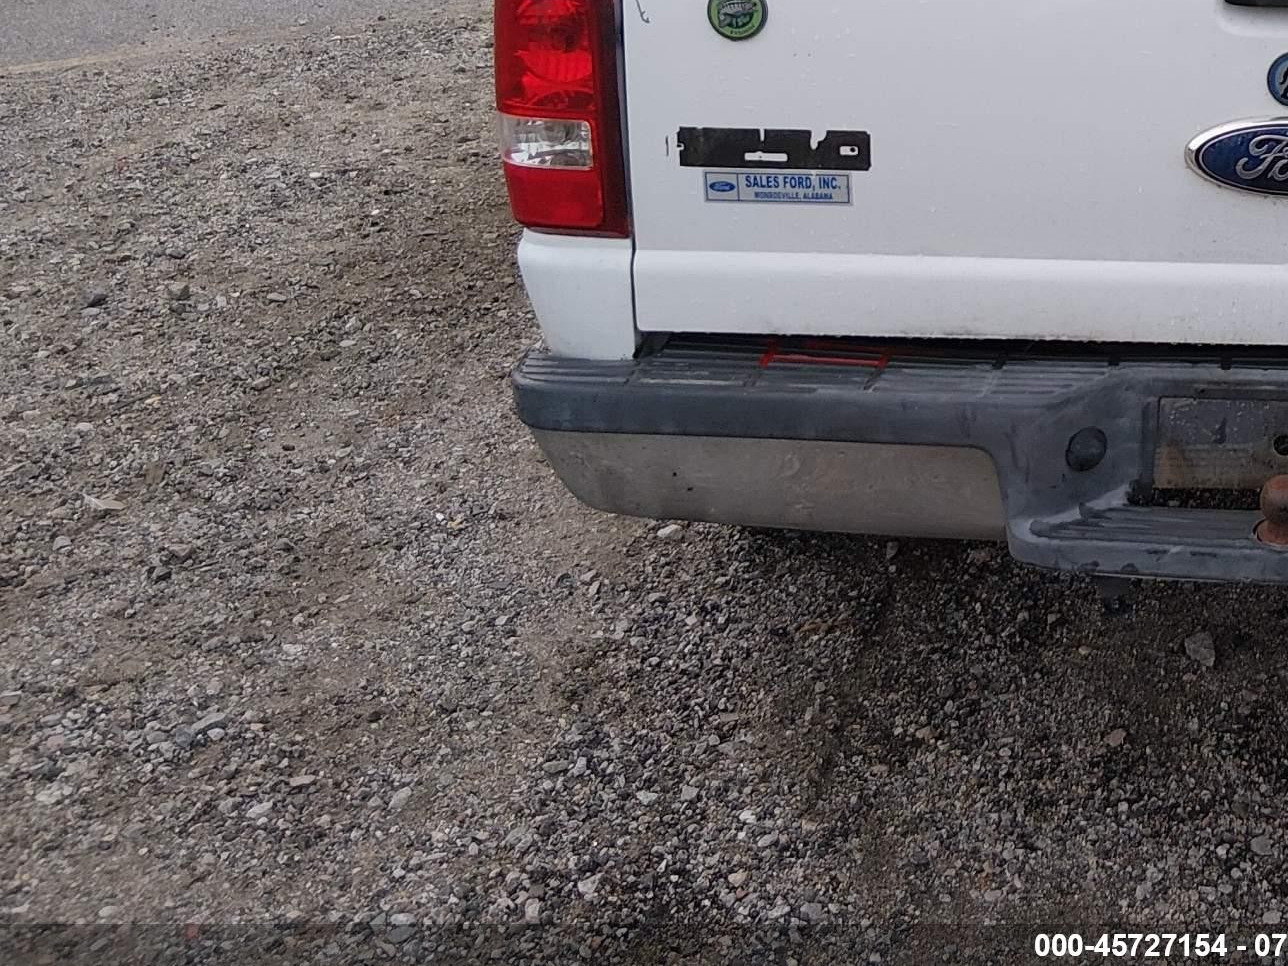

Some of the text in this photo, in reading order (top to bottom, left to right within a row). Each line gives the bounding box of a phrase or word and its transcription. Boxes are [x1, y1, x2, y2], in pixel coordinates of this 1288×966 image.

[745, 175, 841, 191] SALES FORD, INC.
[803, 192, 833, 200] ALABAMA
